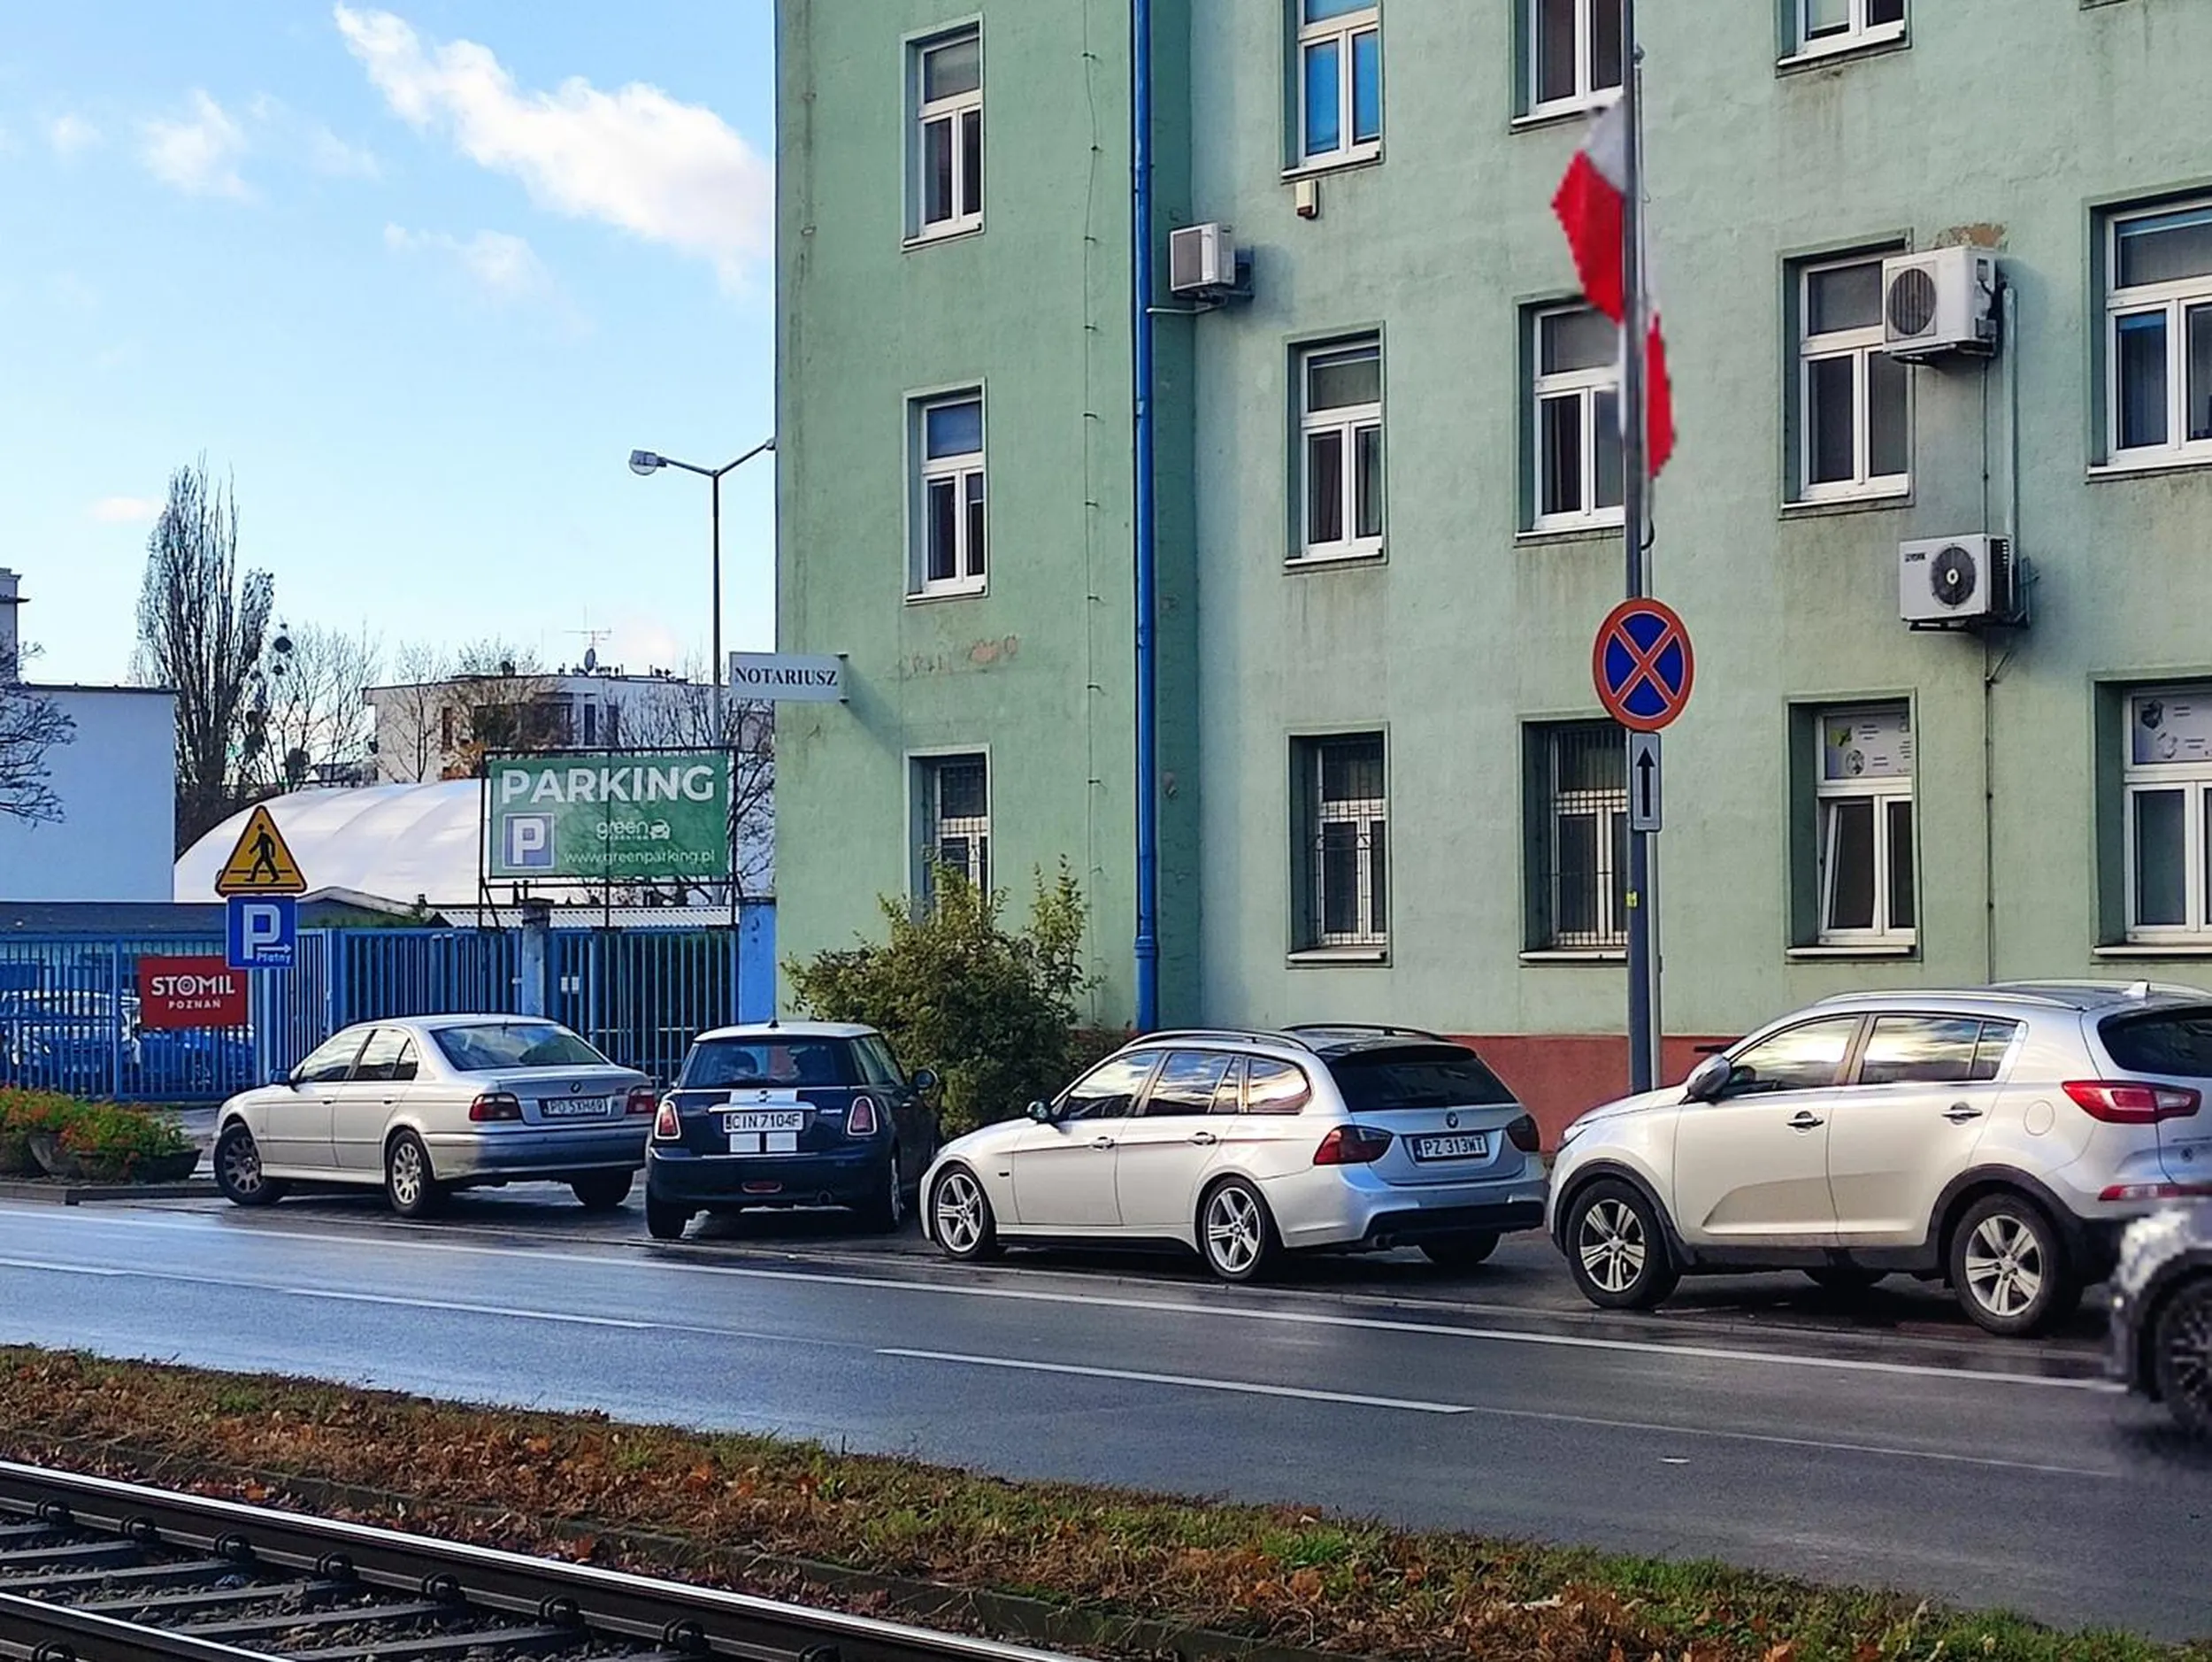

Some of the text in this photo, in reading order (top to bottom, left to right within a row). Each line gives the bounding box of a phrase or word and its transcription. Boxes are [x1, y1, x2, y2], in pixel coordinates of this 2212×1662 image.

[735, 667, 838, 686] NOTARIUSZ
[502, 765, 714, 804] PARKING
[596, 820, 649, 840] green
[512, 818, 545, 866] P
[243, 904, 281, 960] P
[151, 975, 235, 996] STOMIL
[733, 1114, 757, 1128] CIN
[1423, 1140, 1442, 1156] PZ
